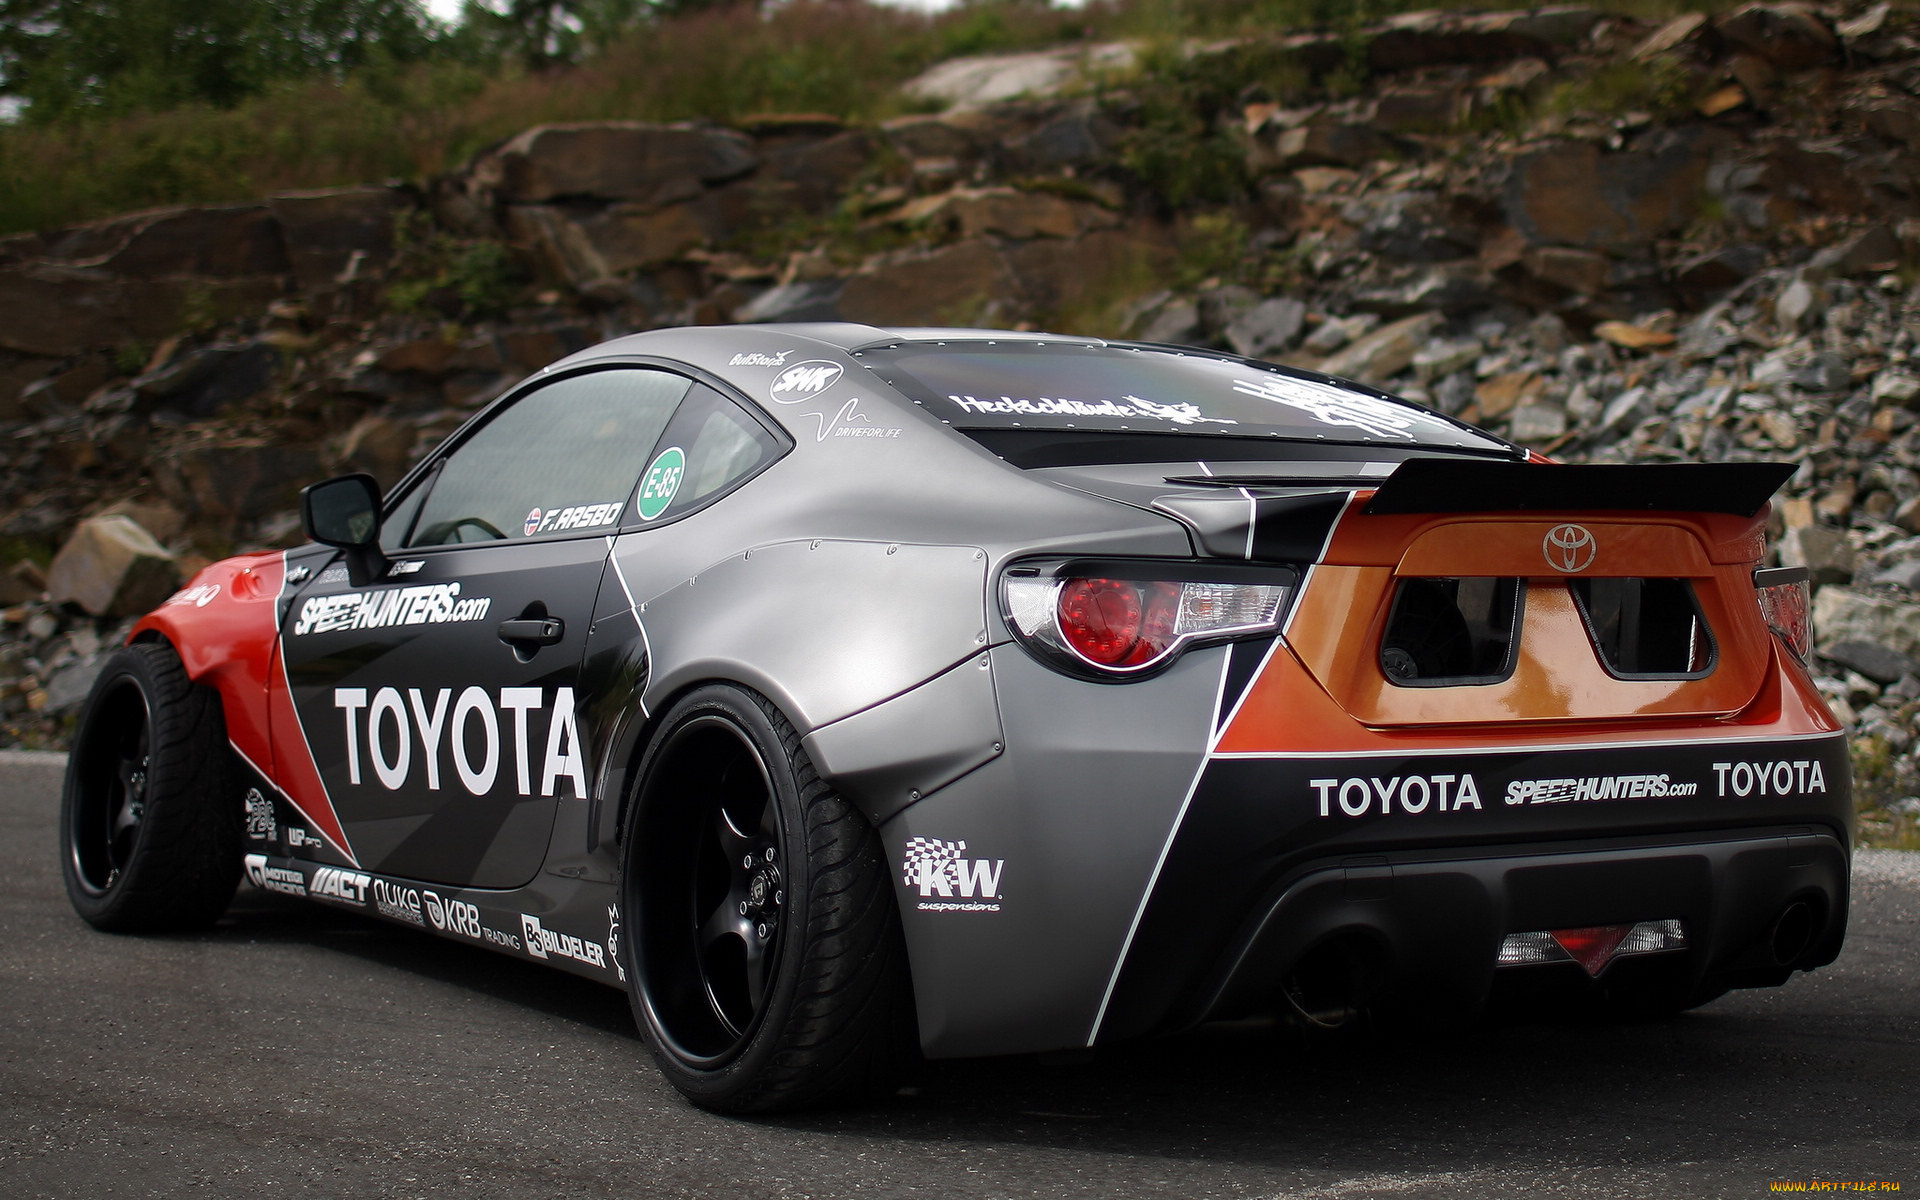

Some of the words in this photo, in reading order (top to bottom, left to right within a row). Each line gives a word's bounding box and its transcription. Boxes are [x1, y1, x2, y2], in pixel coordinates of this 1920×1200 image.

[835, 427, 902, 438] DRIVEFORLIFE
[643, 466, 681, 499] E-85
[294, 582, 491, 636] SPEEDHUNTERS.com
[334, 685, 588, 800] TOYOTA
[1309, 773, 1483, 817] TOYOTA
[1504, 774, 1698, 805] SPEEDHUNTERS.com
[1712, 760, 1827, 797] TOYOTA
[373, 878, 422, 914] nuke
[920, 858, 1005, 898] KW
[444, 897, 481, 939] KRB
[482, 926, 521, 950] TRADING
[917, 900, 1001, 913] suspensions
[541, 928, 607, 969] BILDELER
